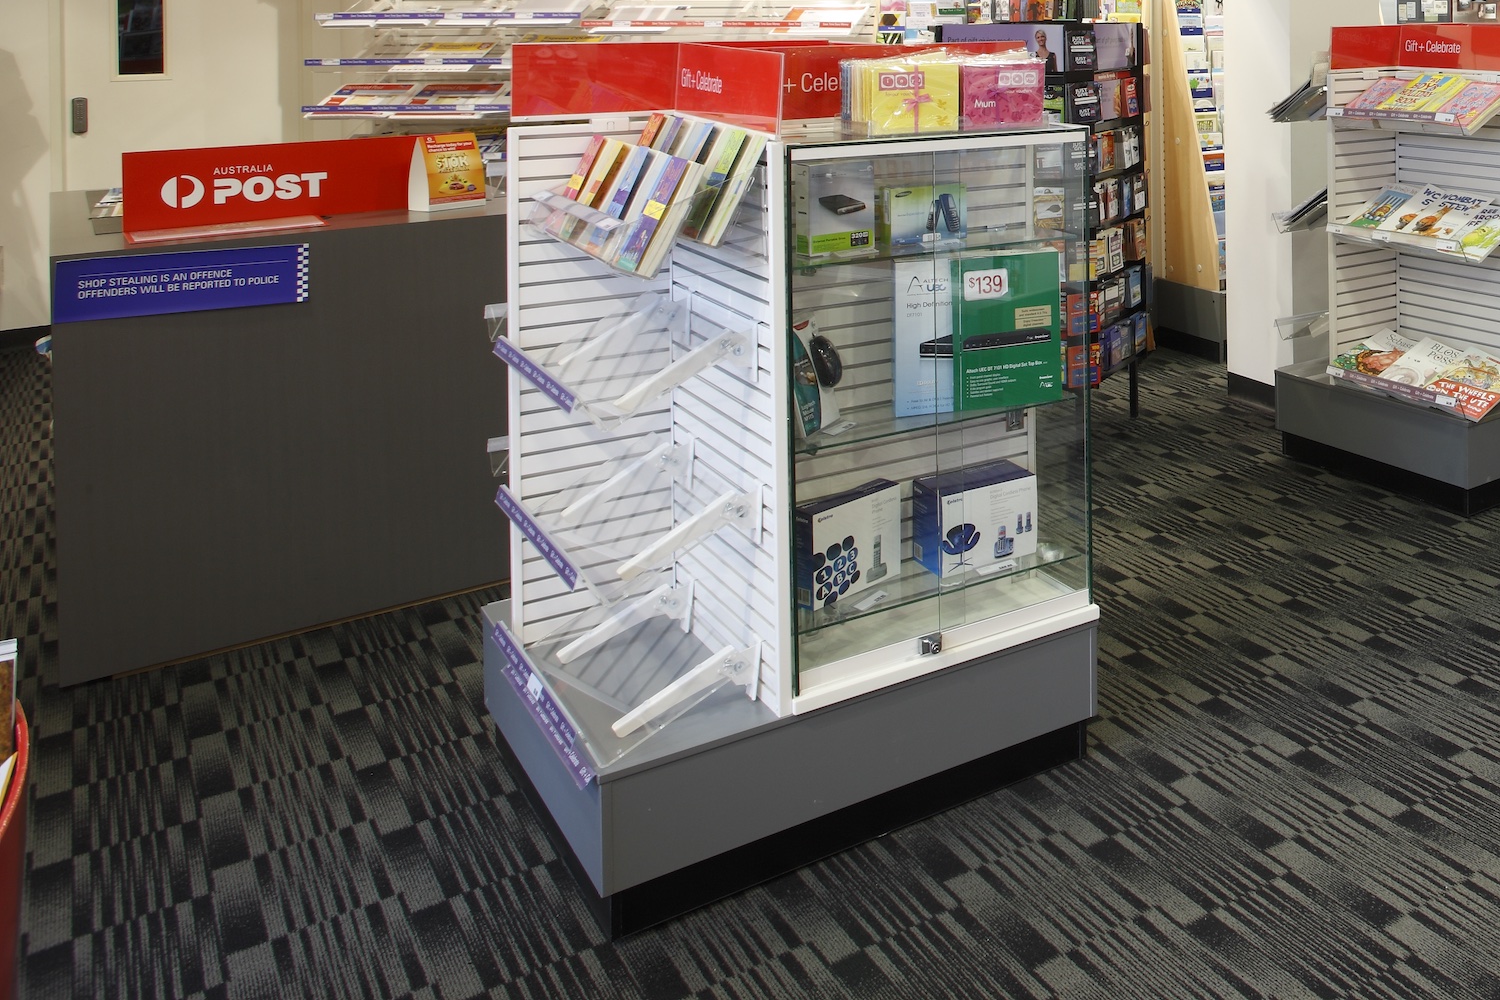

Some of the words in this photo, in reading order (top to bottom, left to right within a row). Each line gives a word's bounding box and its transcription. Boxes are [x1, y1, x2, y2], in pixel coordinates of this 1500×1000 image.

[1405, 39, 1418, 52] Gift
[1425, 40, 1461, 54] Celebrate
[681, 67, 691, 88] Gift
[697, 70, 722, 95] Celebrate
[974, 99, 996, 108] Mum
[213, 163, 273, 175] AUSTRALIA
[436, 155, 469, 169] $10K
[213, 171, 328, 205] POST
[1438, 201, 1472, 212] STEW
[1441, 193, 1488, 206] WOMBAT
[78, 280, 106, 289] SHOP
[109, 274, 157, 287] STEALING
[160, 273, 169, 282] IS
[172, 272, 187, 282] AN
[189, 269, 232, 280] OFFENCE
[968, 274, 1003, 295] $139
[78, 286, 137, 300] OFFENDERS
[140, 284, 165, 294] WILL
[167, 283, 180, 292] BE
[182, 279, 231, 291] REPORTED
[233, 277, 246, 287] TO
[248, 275, 279, 286] POLICE
[906, 302, 921, 310] High
[1386, 333, 1414, 349] Sebast
[1438, 381, 1455, 390] THE
[1459, 386, 1496, 401] WHEELS
[1452, 391, 1469, 401] THE
[1469, 398, 1490, 408] UTE
